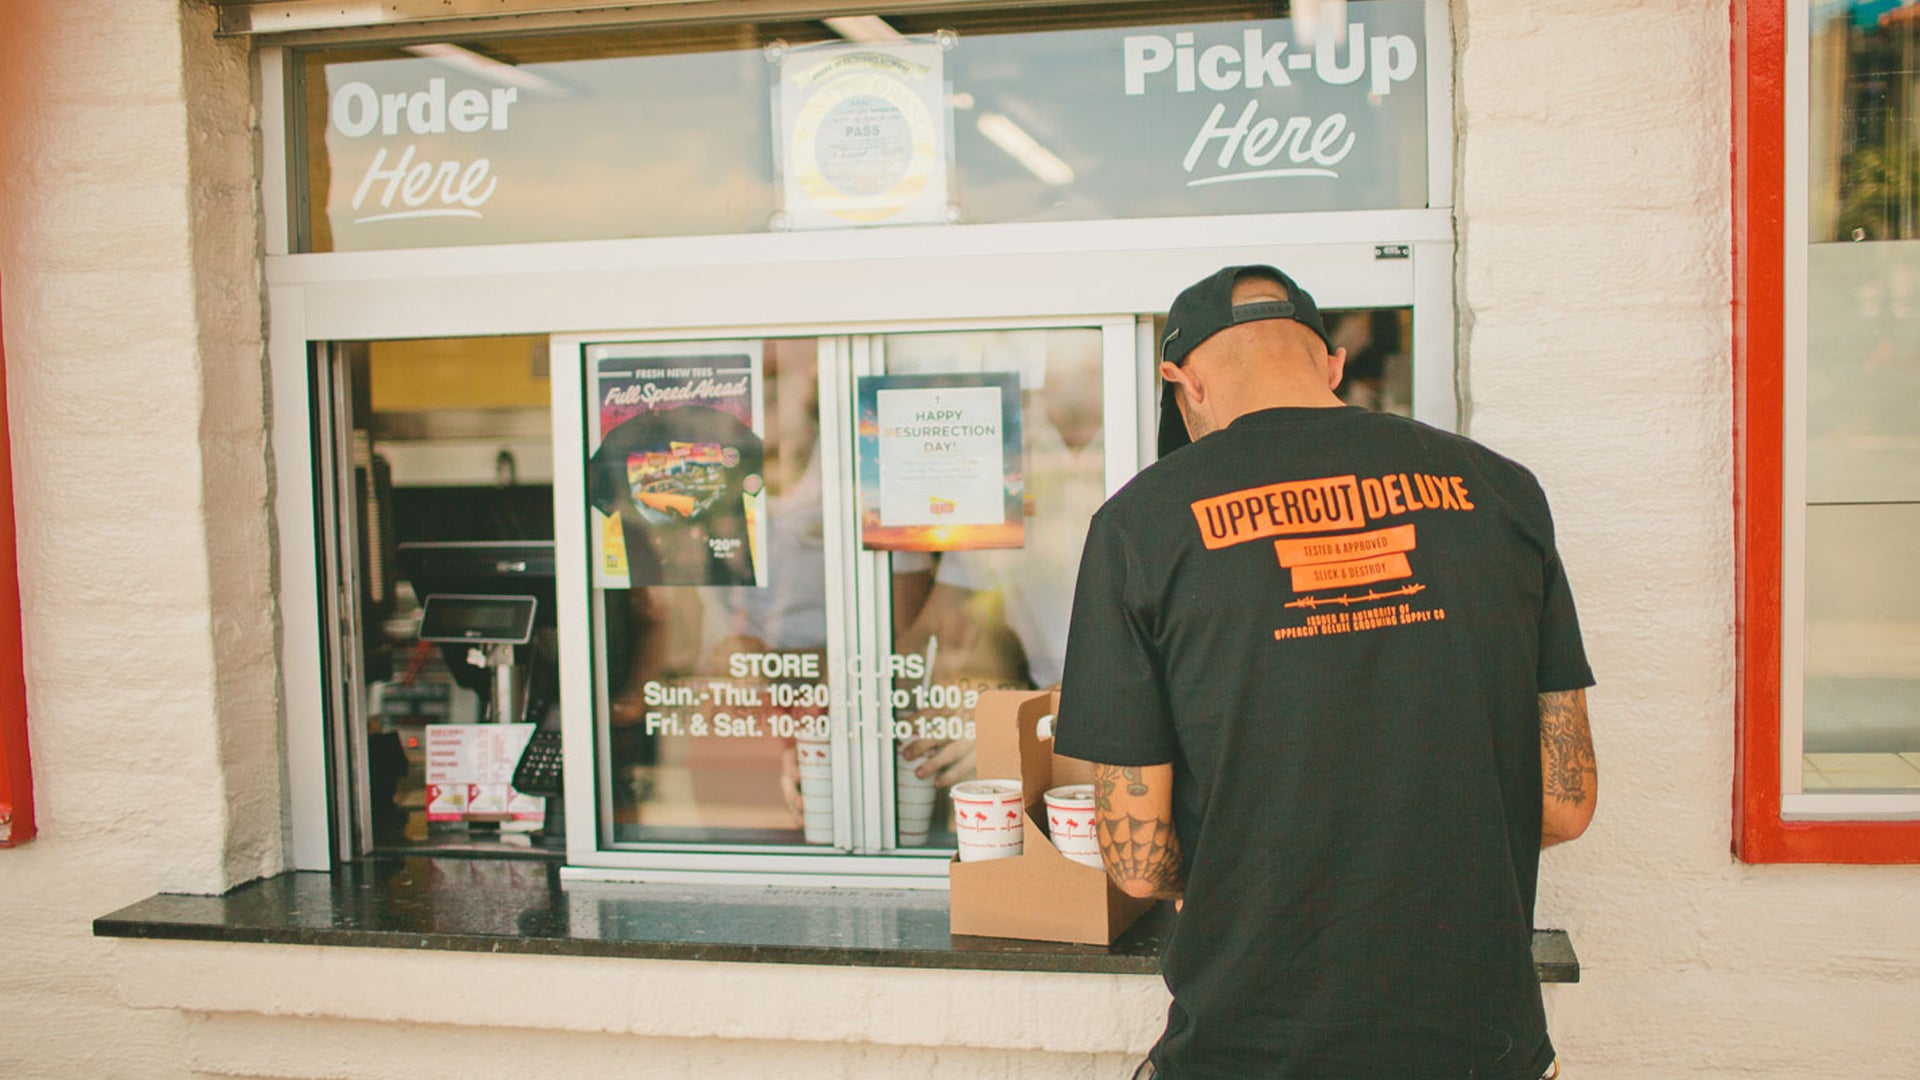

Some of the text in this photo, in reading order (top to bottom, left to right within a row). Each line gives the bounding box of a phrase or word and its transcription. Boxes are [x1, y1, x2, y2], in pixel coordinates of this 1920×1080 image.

[1124, 23, 1417, 95] Pick-Up
[332, 78, 517, 137] Order
[846, 124, 880, 137] PASS
[1183, 99, 1356, 172] Here
[352, 145, 498, 210] Here
[635, 368, 665, 379] FRESH
[667, 368, 691, 378] NEW
[604, 376, 748, 409] Full Speed Ahead
[916, 410, 963, 422] HAPPY
[924, 441, 957, 452] DAY!
[1205, 472, 1475, 539] UPPERCUT DELUXE
[1304, 544, 1333, 557] TESTED
[1343, 537, 1388, 553] APPROVED
[1314, 568, 1340, 581] SLICK
[1349, 562, 1387, 578] DESTROY
[1274, 625, 1318, 641] UPPERCUT
[1400, 609, 1431, 625] SUPPLY
[1433, 608, 1446, 620] CO
[1352, 606, 1396, 622] AUTHORITY
[729, 652, 925, 679] STORE OURS
[643, 680, 763, 707] Sun.-Thu.
[767, 683, 830, 708] 10:30
[912, 684, 961, 709] 1:00
[645, 711, 684, 736] Fri.
[689, 713, 708, 737] &
[713, 713, 763, 737] Sat.
[767, 715, 831, 738] 10:30
[915, 715, 962, 740] 1:30
